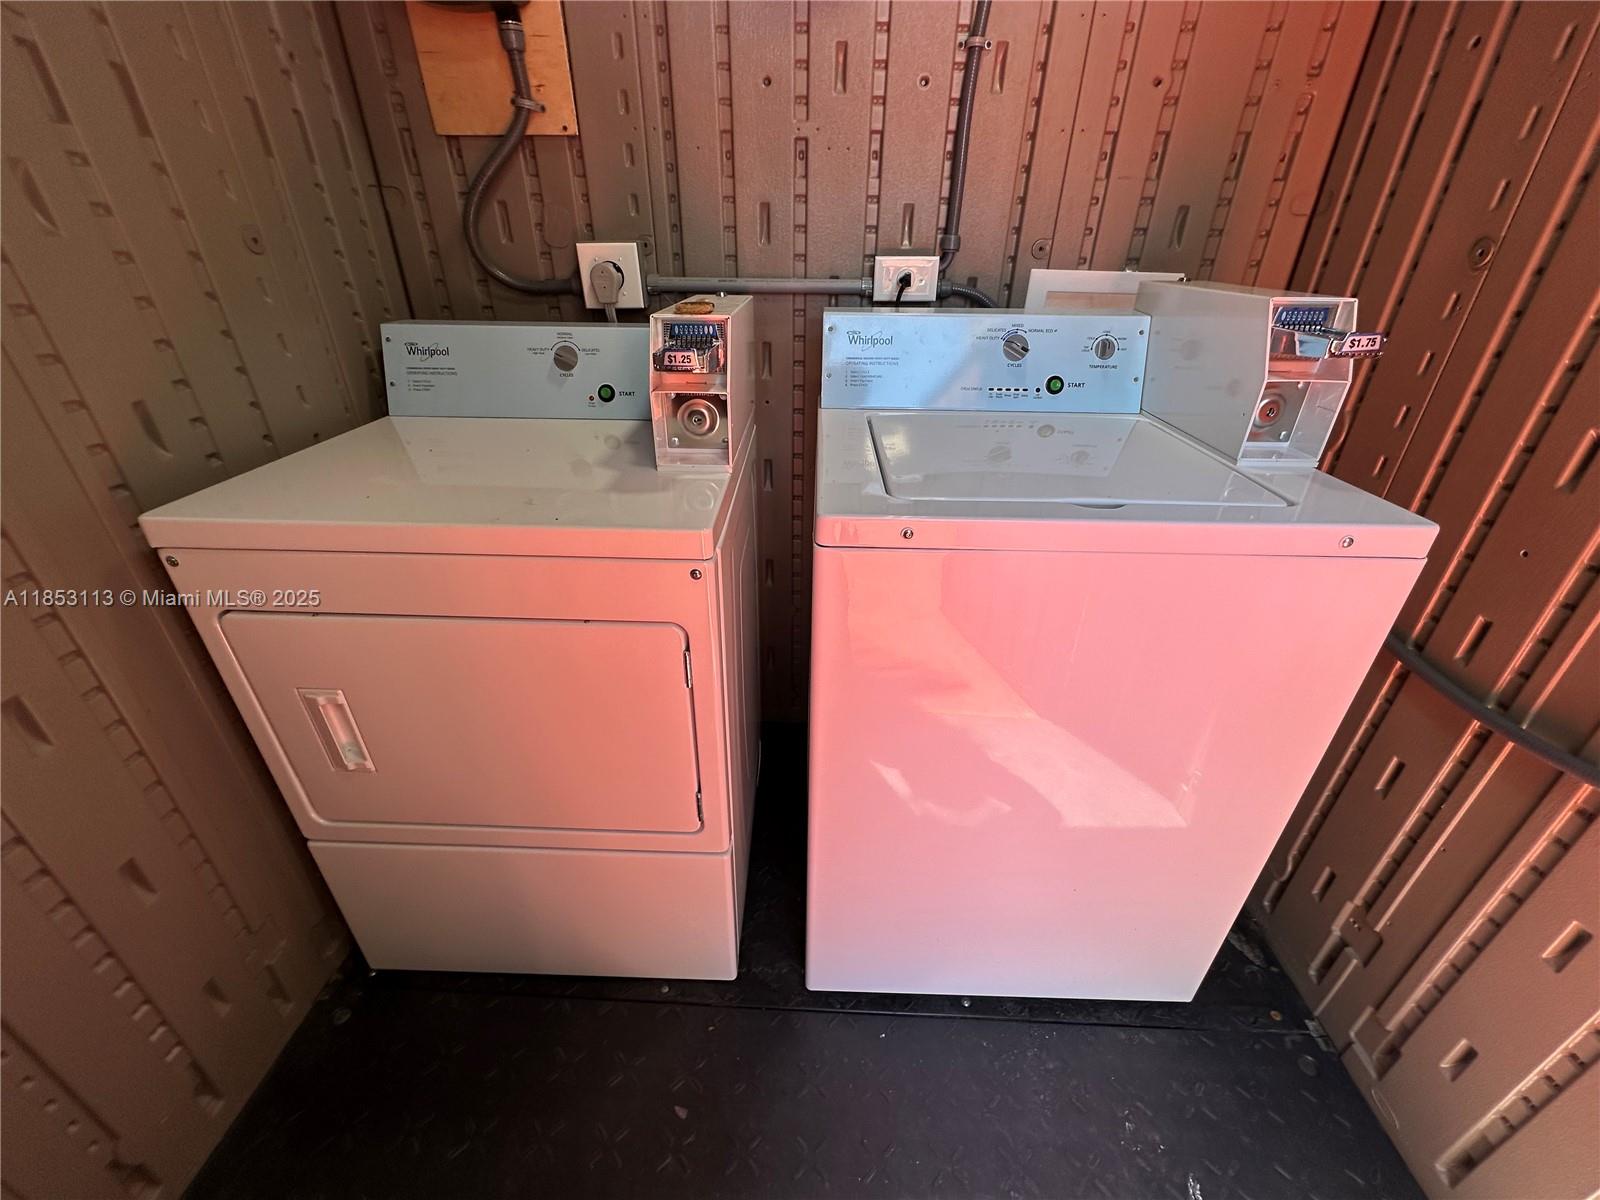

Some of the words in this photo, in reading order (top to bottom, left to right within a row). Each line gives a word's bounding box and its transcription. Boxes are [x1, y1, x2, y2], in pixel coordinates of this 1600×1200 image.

[848, 335, 893, 348] Whirlpool
[1348, 337, 1378, 349] $1.75
[405, 346, 449, 358] Whirlpool
[667, 354, 692, 364] $1.25
